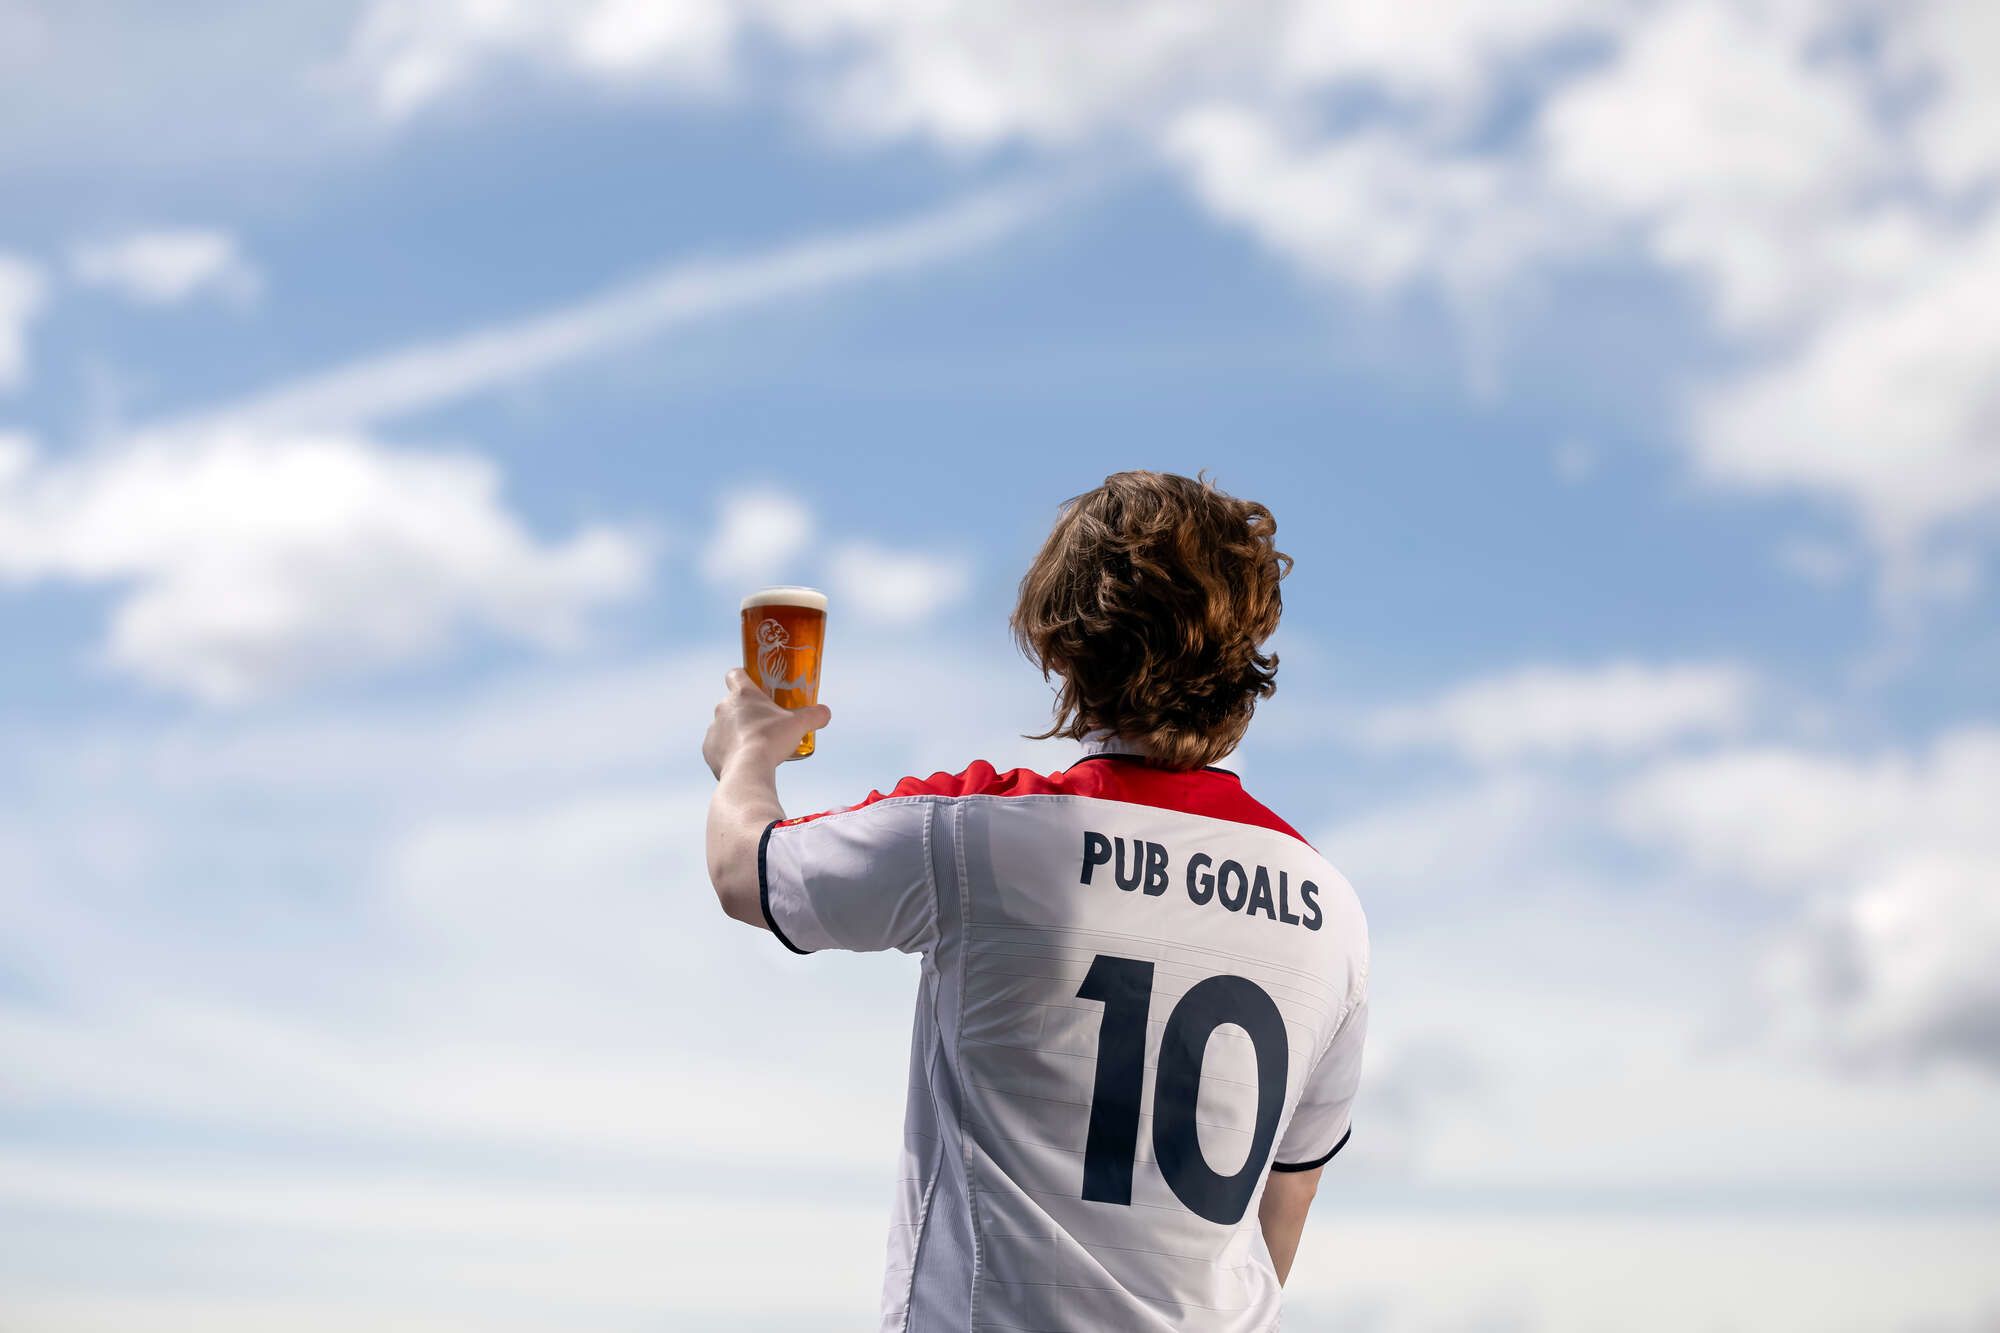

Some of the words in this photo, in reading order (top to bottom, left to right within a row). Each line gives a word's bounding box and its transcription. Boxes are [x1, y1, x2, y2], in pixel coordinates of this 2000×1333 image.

[1080, 831, 1169, 897] PUB
[1186, 853, 1323, 931] GOALS
[1075, 954, 1289, 1226] 10
